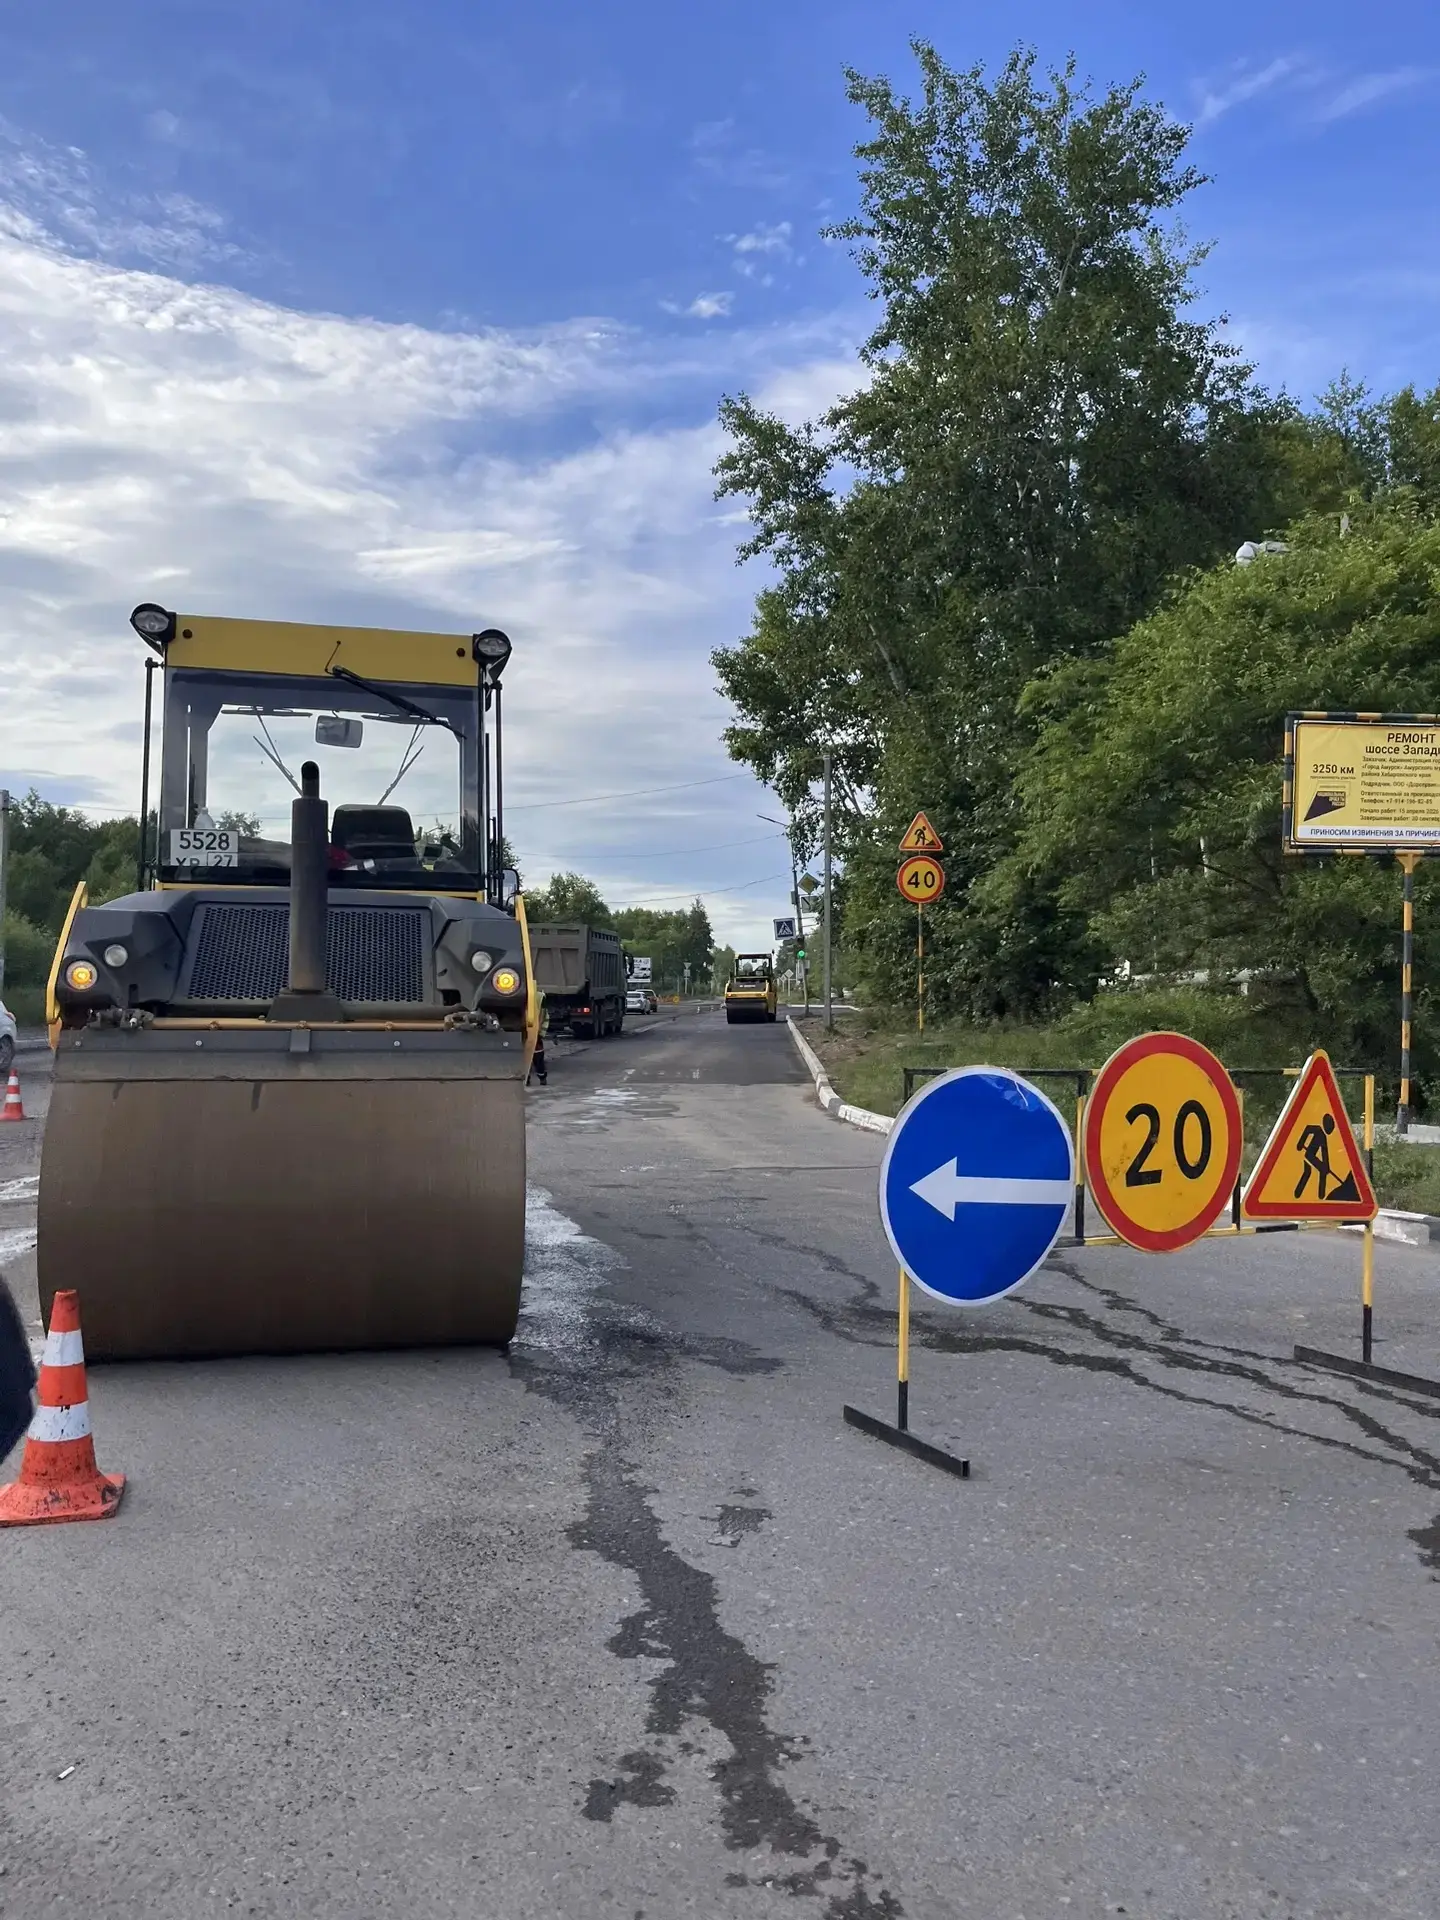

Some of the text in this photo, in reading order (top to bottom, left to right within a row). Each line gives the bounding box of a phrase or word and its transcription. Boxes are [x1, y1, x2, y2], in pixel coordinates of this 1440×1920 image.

[1387, 733, 1436, 744] РЕМОНТ
[1366, 745, 1400, 755] шоссе
[1313, 764, 1354, 774] 3250 км
[1310, 828, 1350, 836] ПРИНОСИМ
[1352, 829, 1393, 837] ИЗВИНЕНИЯ
[179, 831, 230, 851] 5528
[213, 855, 233, 867] 27
[907, 871, 935, 888] 40
[1125, 1100, 1212, 1187] 20
